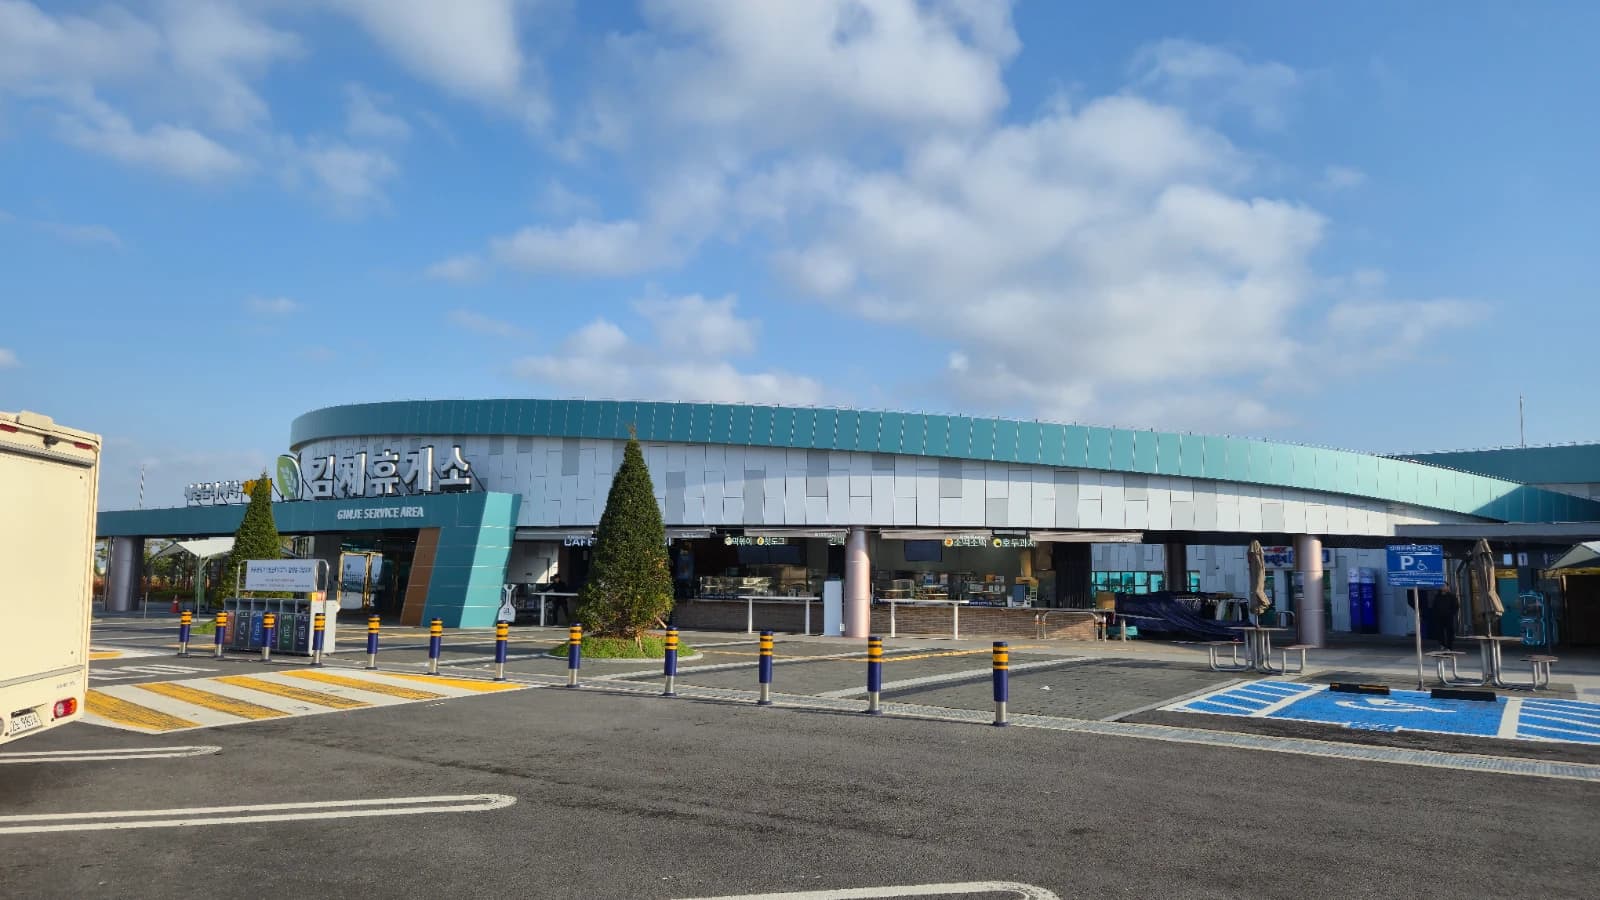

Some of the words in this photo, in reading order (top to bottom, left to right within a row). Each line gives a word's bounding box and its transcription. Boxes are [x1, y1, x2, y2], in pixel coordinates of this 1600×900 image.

[312, 446, 472, 500] 김제휴게소
[337, 509, 363, 520] GIMJE
[364, 508, 399, 519] SERVICE
[400, 506, 424, 518] AREA
[764, 536, 785, 546] 핫도그
[1002, 537, 1036, 548] 호두과자
[1400, 555, 1414, 570] P
